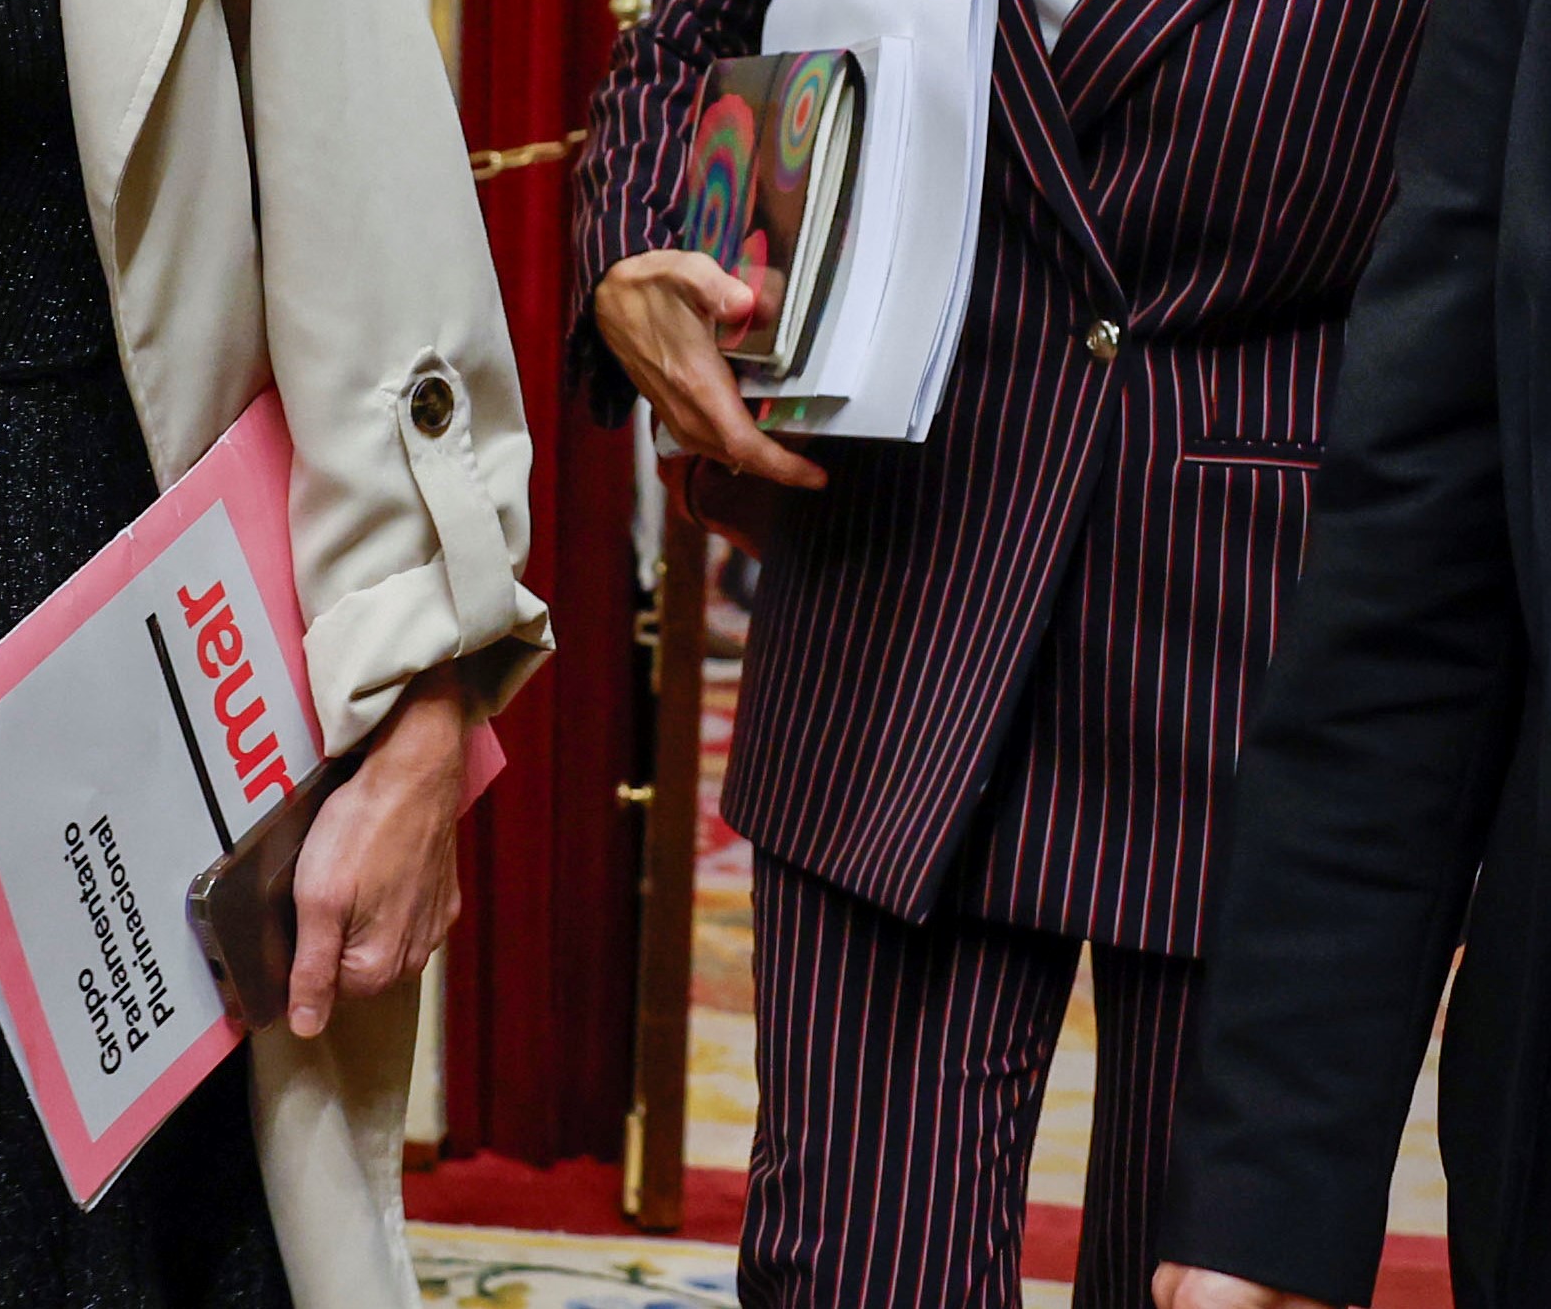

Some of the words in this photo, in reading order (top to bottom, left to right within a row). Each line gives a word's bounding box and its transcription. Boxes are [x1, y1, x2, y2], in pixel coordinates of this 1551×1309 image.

[176, 580, 298, 805] umar
[64, 822, 150, 1053] Parlamentario
[78, 968, 122, 1075] Grupo
[89, 814, 176, 1028] Plurinacional
